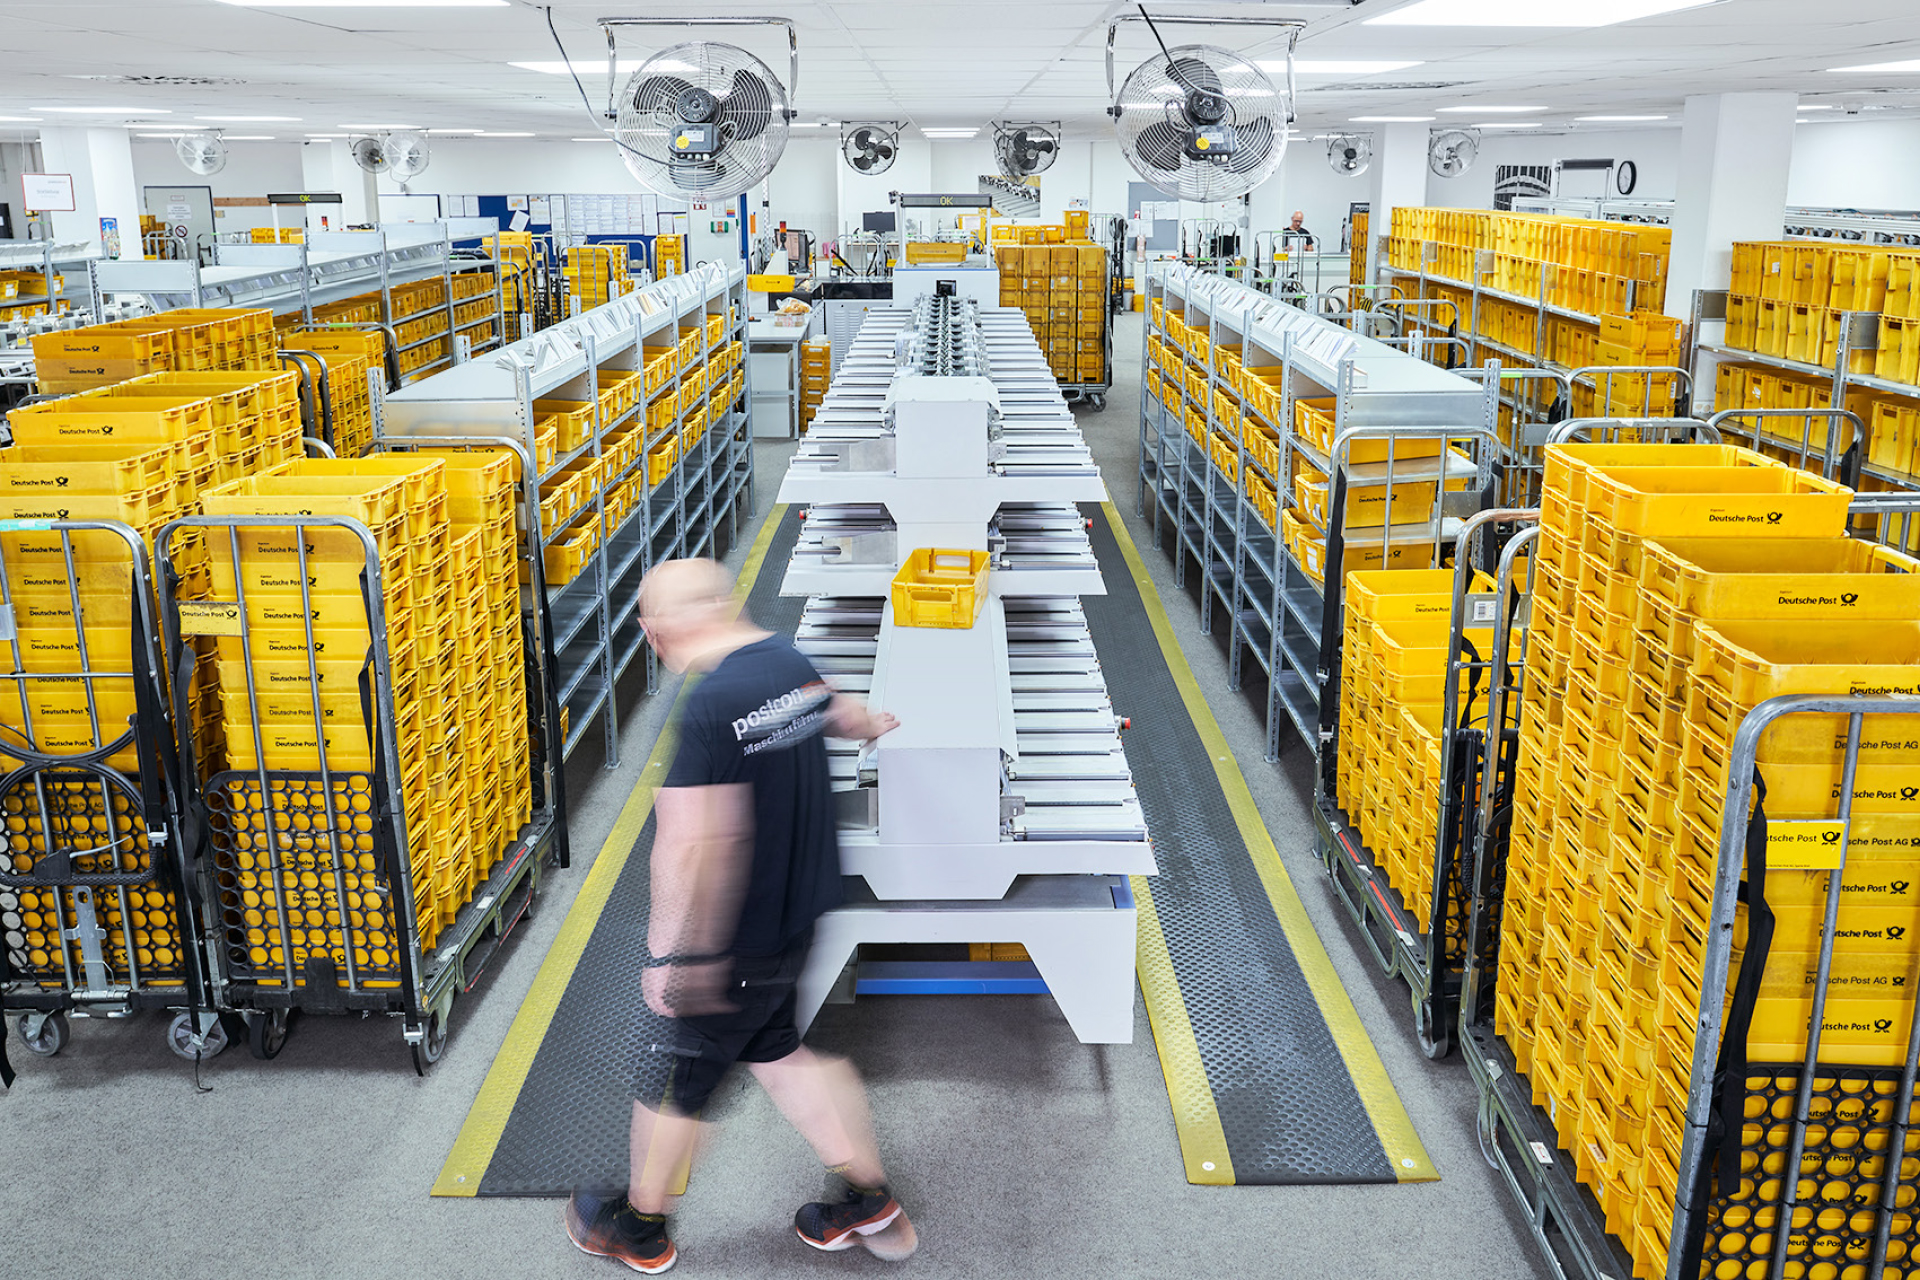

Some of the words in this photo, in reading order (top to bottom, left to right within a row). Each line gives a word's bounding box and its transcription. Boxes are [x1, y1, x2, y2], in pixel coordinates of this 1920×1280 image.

[299, 194, 312, 202] OK
[939, 196, 954, 206] OK
[1778, 596, 1818, 605] Deutsche
[1818, 596, 1837, 605] Post
[1850, 686, 1892, 694] Deutsche
[1894, 686, 1913, 694] Post
[732, 688, 804, 741] postcon
[1881, 740, 1901, 749] Post
[1904, 740, 1918, 749] AG
[1876, 790, 1897, 799] Post
[1867, 884, 1887, 892] Post
[1862, 930, 1882, 938] Post
[1850, 976, 1870, 984] Post
[1873, 976, 1888, 984] AG
[1850, 1023, 1870, 1031] Post
